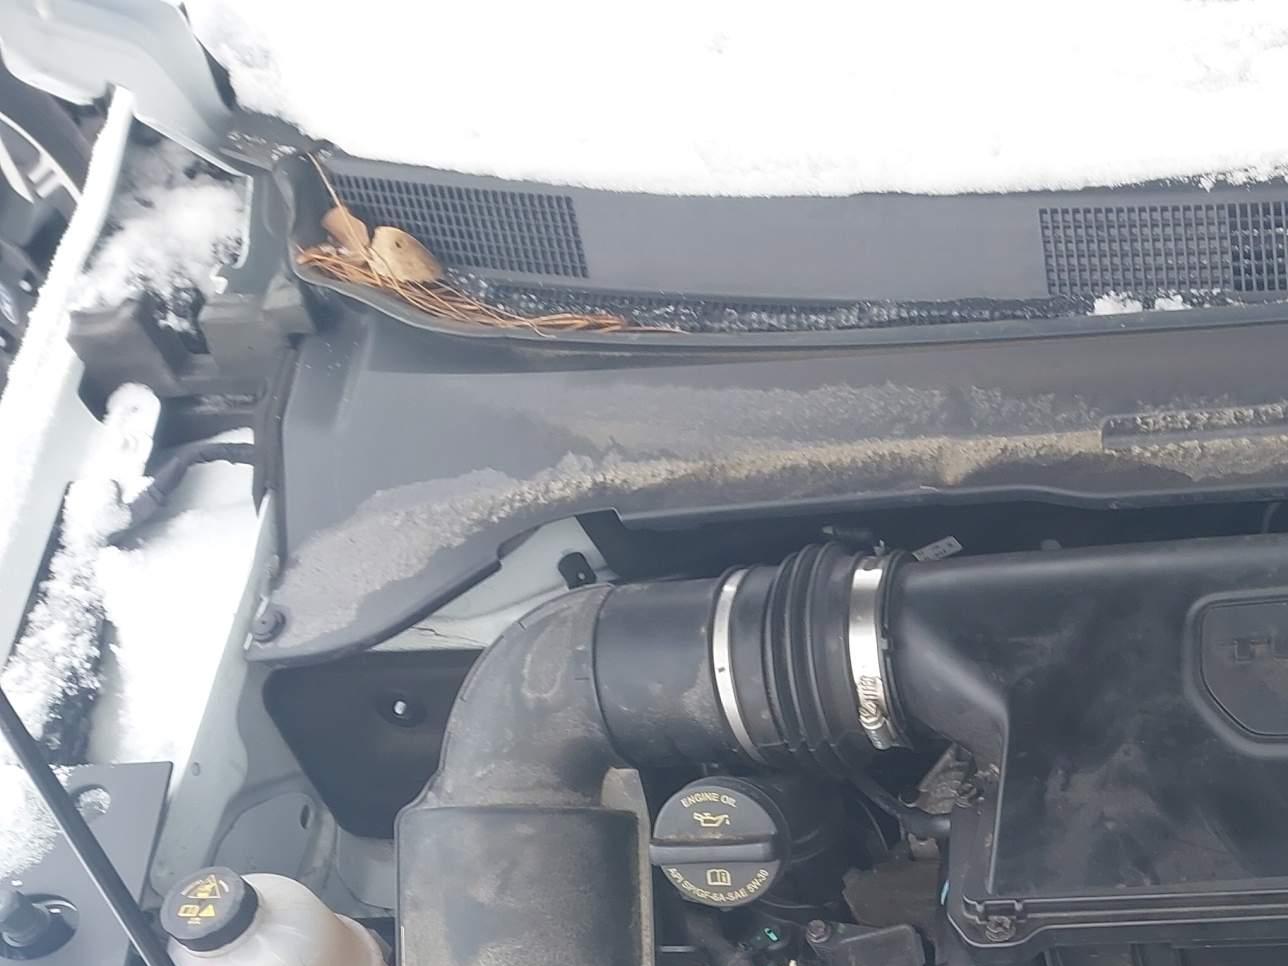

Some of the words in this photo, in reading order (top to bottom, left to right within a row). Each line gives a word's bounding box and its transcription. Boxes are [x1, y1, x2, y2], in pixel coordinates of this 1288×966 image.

[680, 792, 720, 808] ENGINE
[720, 794, 737, 808] OIL
[747, 869, 769, 893] 5W-30
